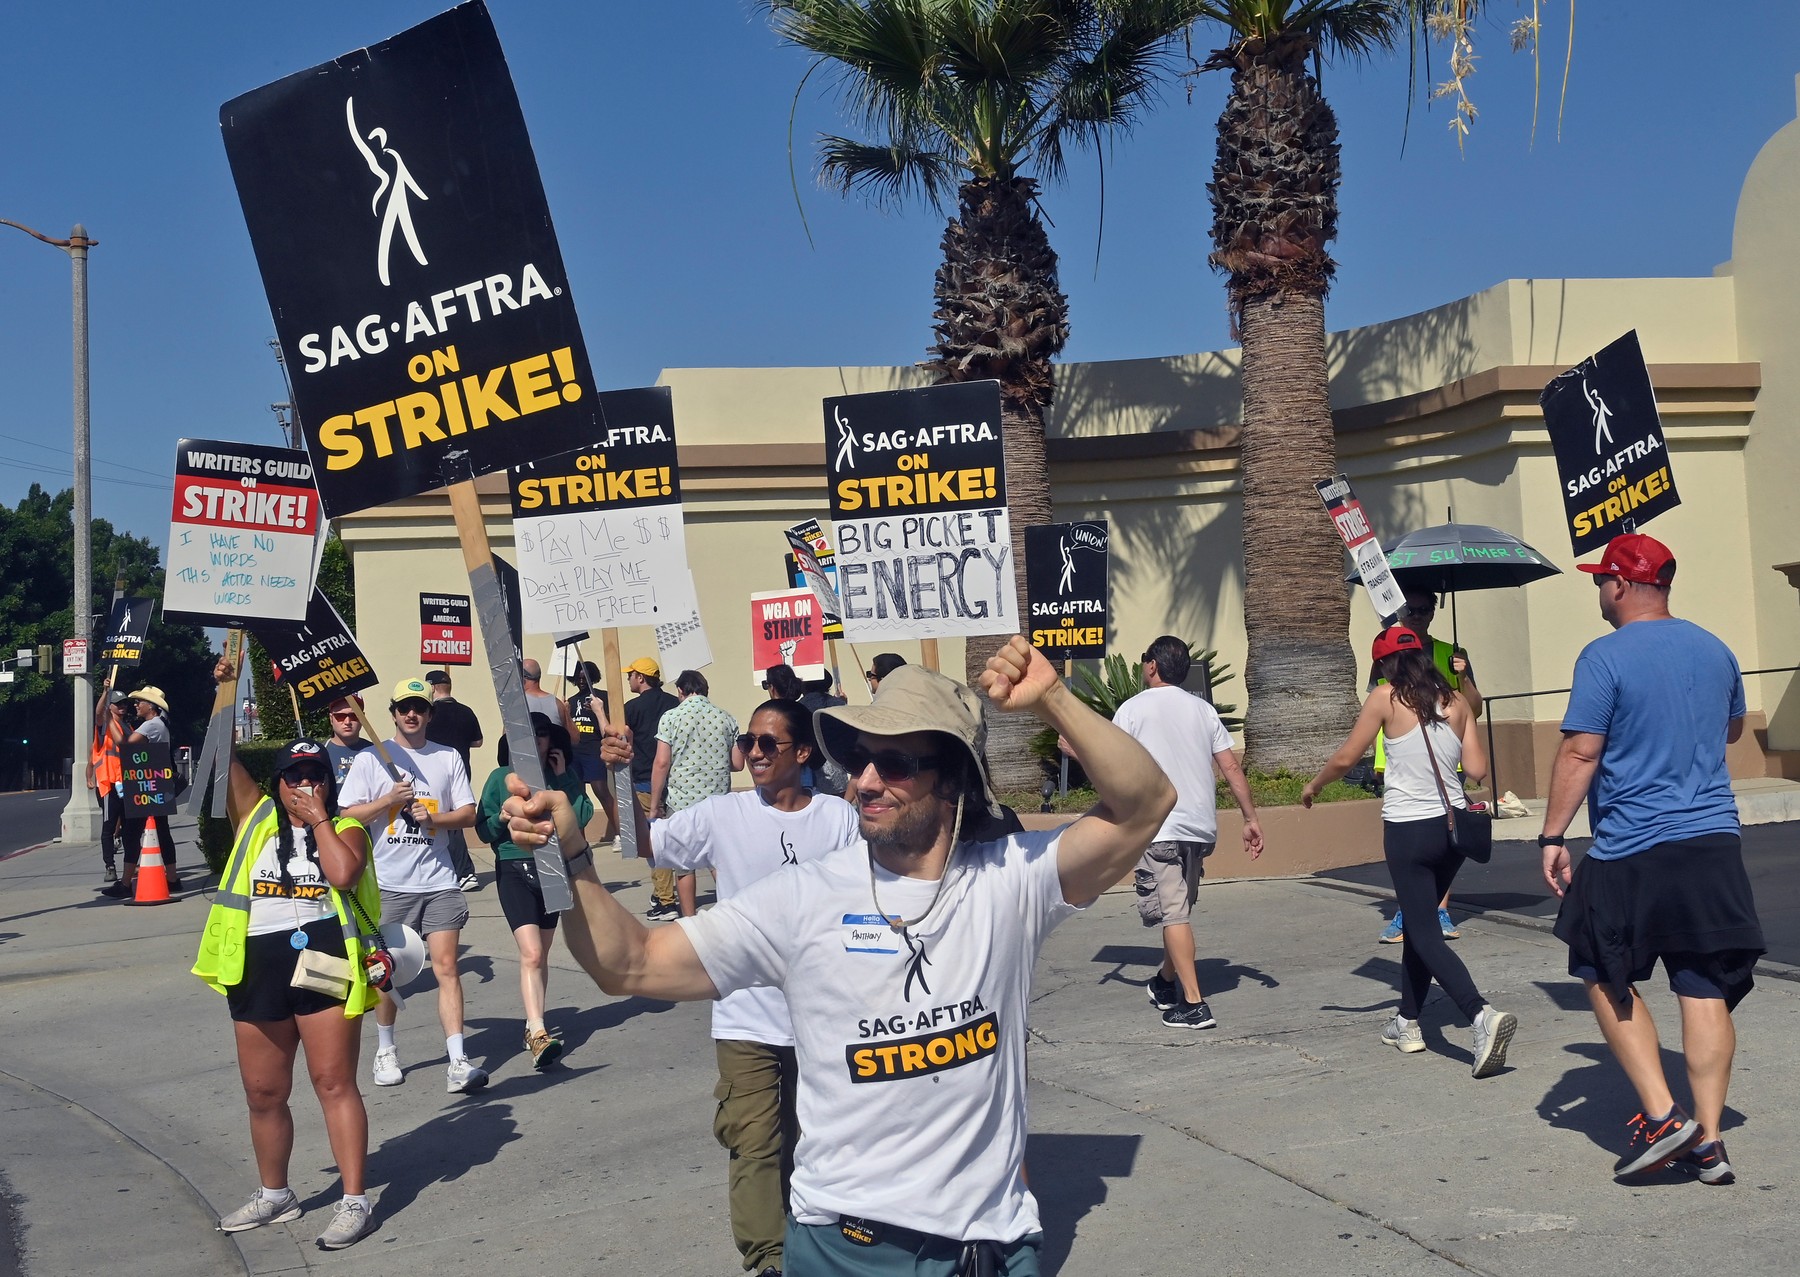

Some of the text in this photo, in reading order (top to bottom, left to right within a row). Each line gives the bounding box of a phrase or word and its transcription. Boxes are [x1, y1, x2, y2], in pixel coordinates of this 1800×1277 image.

[407, 345, 460, 383] ON
[318, 346, 582, 471] STRIKE!
[187, 451, 312, 480] WRITERS GUILD
[575, 454, 607, 471] ON
[897, 453, 929, 471] ON
[240, 477, 257, 488] ON
[517, 466, 672, 509] STRIKE!
[837, 467, 997, 511] STRIKE!
[1608, 474, 1627, 494] ON
[182, 485, 308, 529] STRIKE!
[1573, 466, 1670, 537] STRIKE!
[180, 530, 274, 552] I HAVE NO
[838, 509, 1003, 555] BIG PICKET
[1075, 529, 1108, 549] UNION!
[210, 551, 258, 567] WORDS
[1430, 546, 1510, 563] SUMMER
[176, 567, 296, 588] THIS ACTOR NEEDS
[574, 565, 614, 592] PLAY
[620, 560, 650, 581] ME
[839, 547, 1009, 620] ENERGY
[214, 592, 252, 605] WORDS
[422, 598, 468, 607] WRITERS GUILD
[432, 615, 460, 623] AMERICA
[554, 601, 588, 625] FOR
[762, 599, 812, 620] WGA ON
[764, 617, 812, 641] STRIKE
[1061, 618, 1074, 627] ON
[442, 629, 453, 638] ON
[1032, 627, 1104, 647] STRIKE!
[102, 649, 140, 659] STRIKE!
[423, 639, 471, 655] STRIKE!
[318, 656, 334, 669] ON
[297, 656, 370, 699] STRIKE!
[132, 751, 148, 764] GO
[123, 768, 172, 780] AROUND
[138, 780, 157, 792] THE
[134, 793, 164, 806] CONE
[853, 1021, 997, 1077] STRONG
[843, 1228, 872, 1243] STRIKE!
